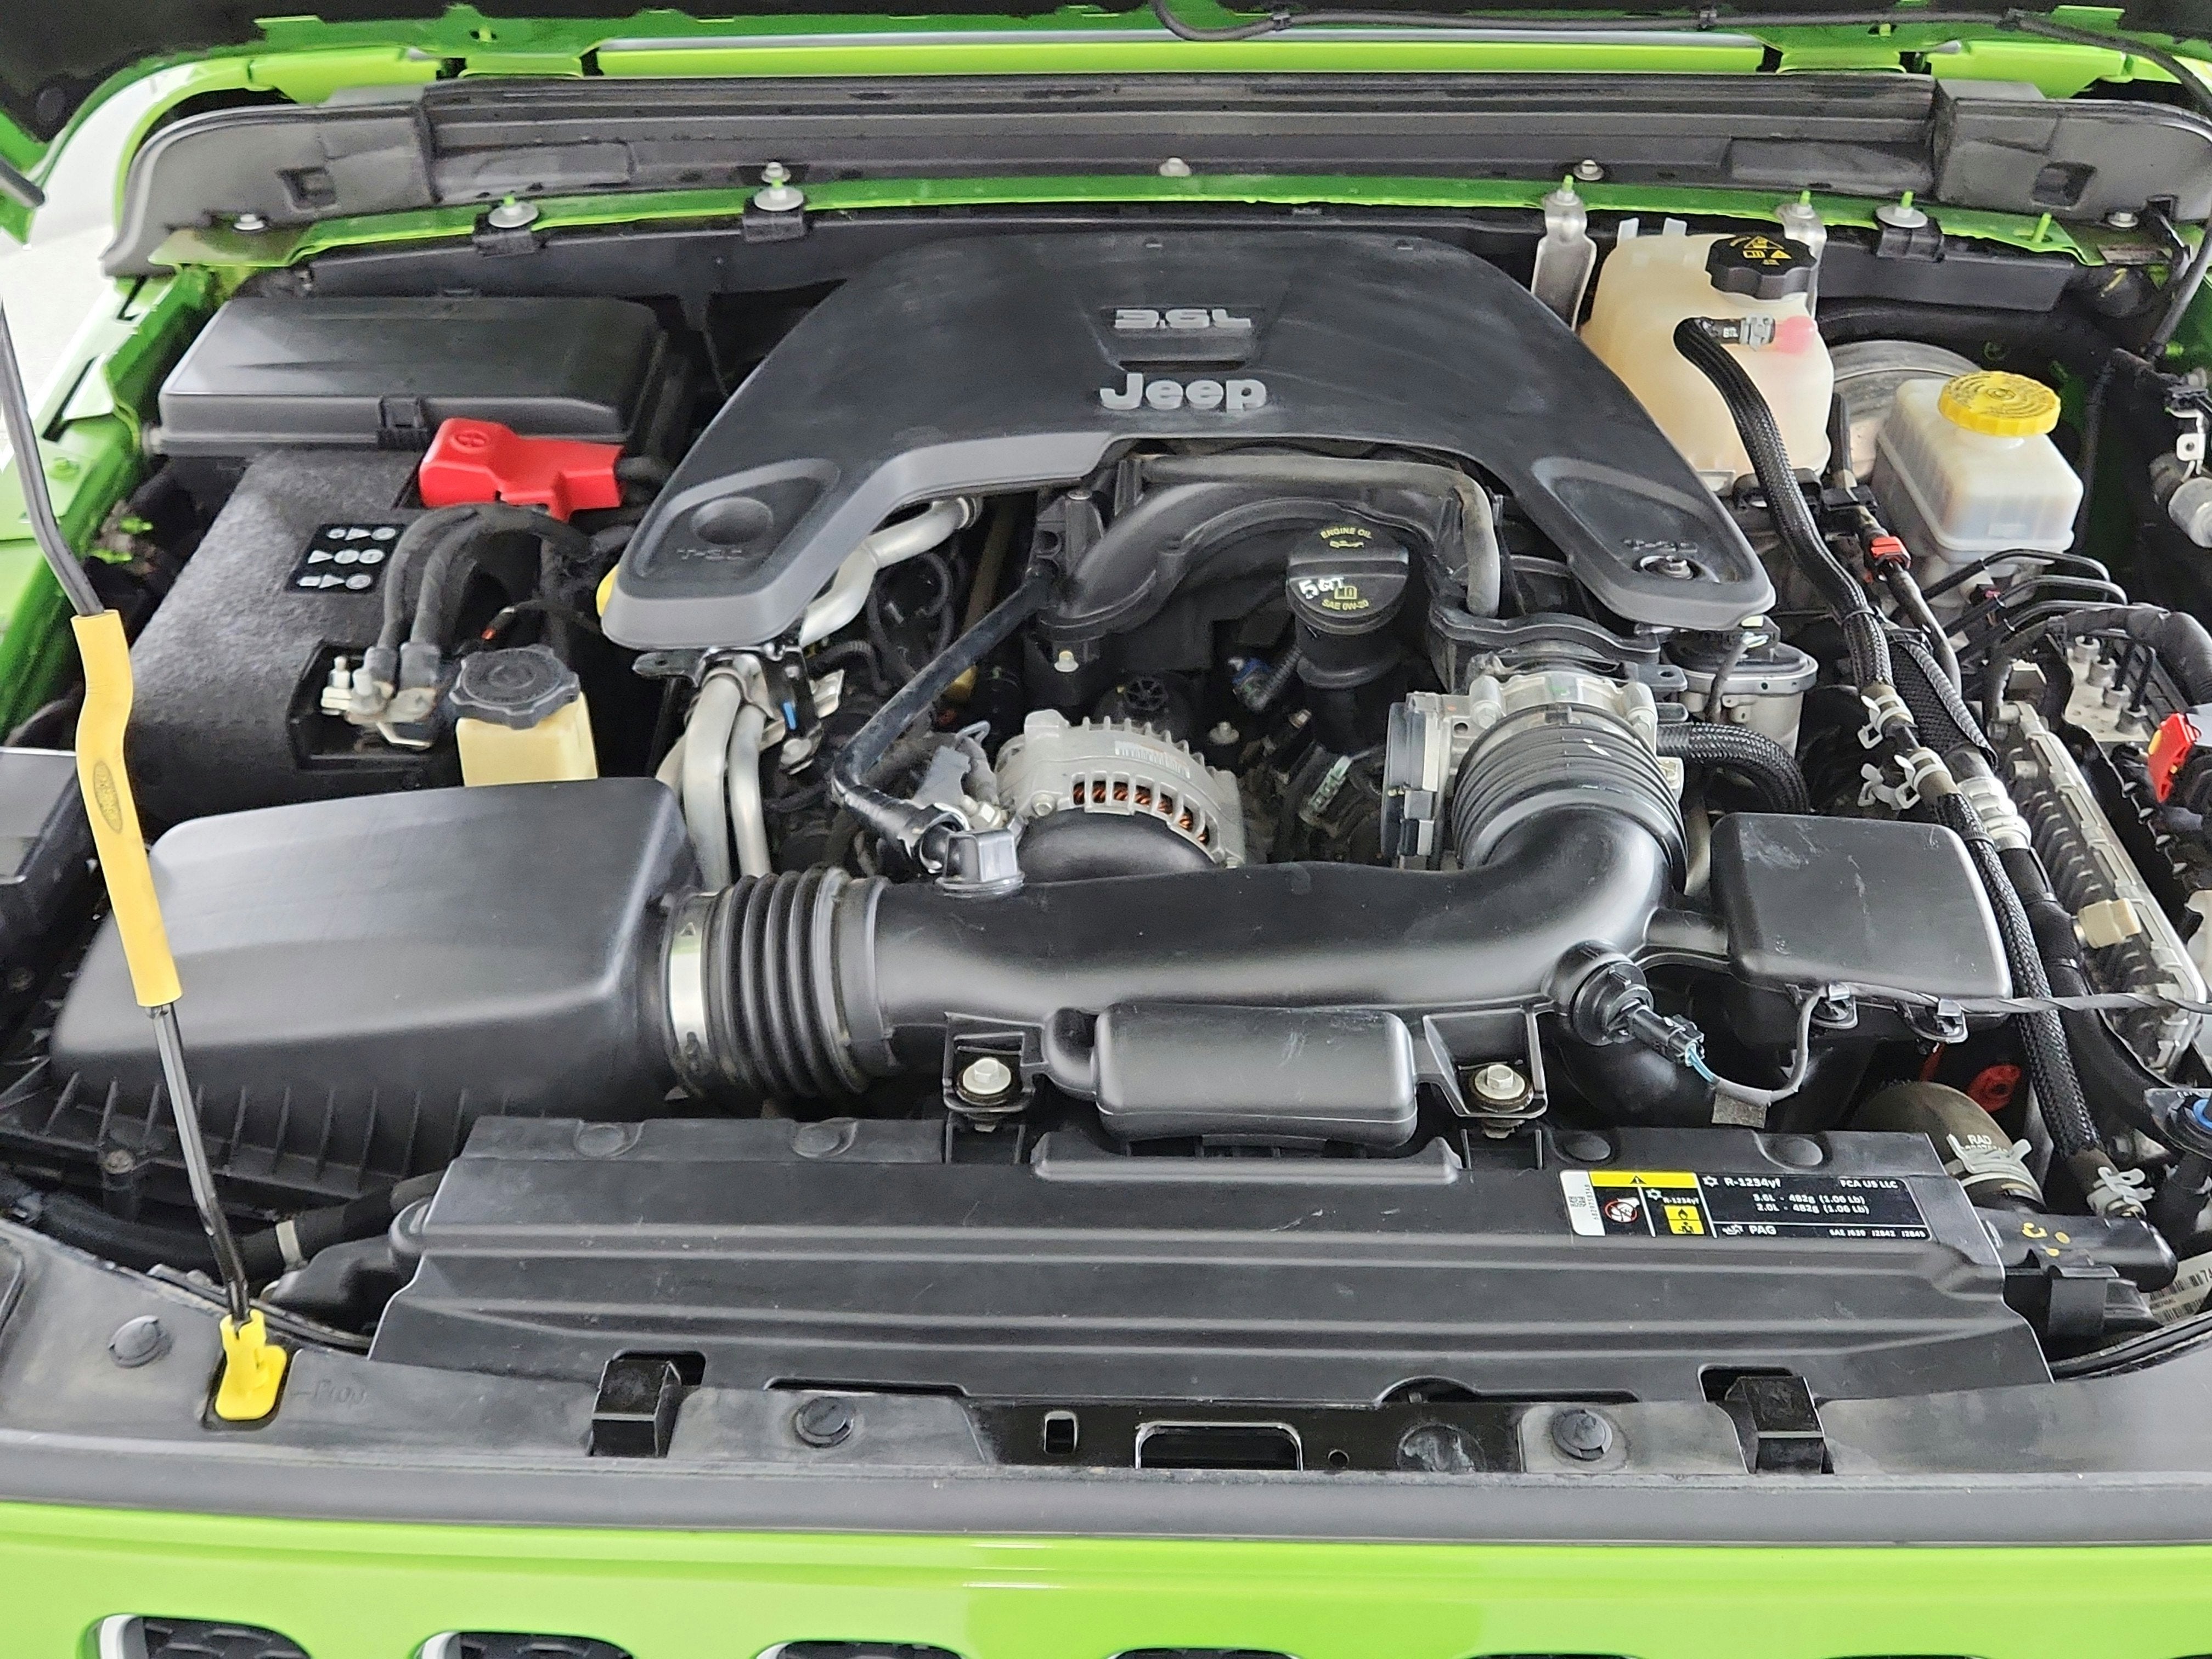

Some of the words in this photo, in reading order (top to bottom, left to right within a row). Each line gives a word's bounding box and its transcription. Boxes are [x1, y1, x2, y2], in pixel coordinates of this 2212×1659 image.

[1115, 309, 1251, 329] 3.6L
[1099, 373, 1267, 413] Jeep
[1320, 527, 1355, 539] ENGINE
[1357, 529, 1372, 539] OIL
[1322, 599, 1341, 610] SAE
[1342, 600, 1369, 610] 0W-20
[1967, 1134, 1992, 1145] RAD
[1724, 1177, 1781, 1189] R-1234yf
[1879, 1181, 1898, 1189] LLC
[1753, 1193, 1776, 1201] 3.6L
[1756, 1203, 1780, 1211] 2.0L
[1748, 1225, 1777, 1235] PAG
